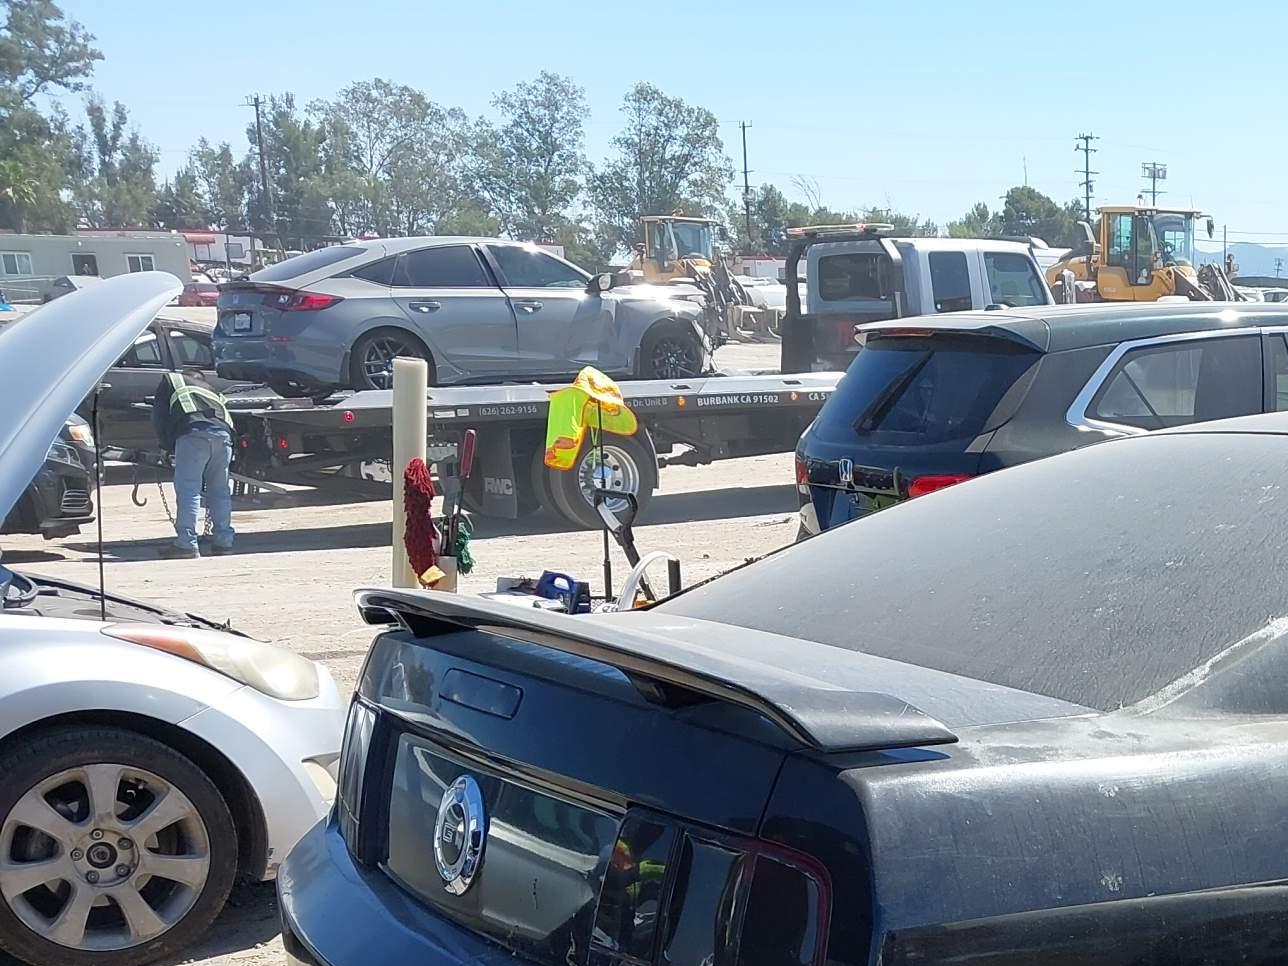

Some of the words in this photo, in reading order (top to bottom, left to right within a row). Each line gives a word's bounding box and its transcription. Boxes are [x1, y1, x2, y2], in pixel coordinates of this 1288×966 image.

[697, 396, 739, 406] BURBANK
[740, 395, 751, 404] CA
[753, 394, 778, 404] 91502
[808, 391, 819, 401] CA
